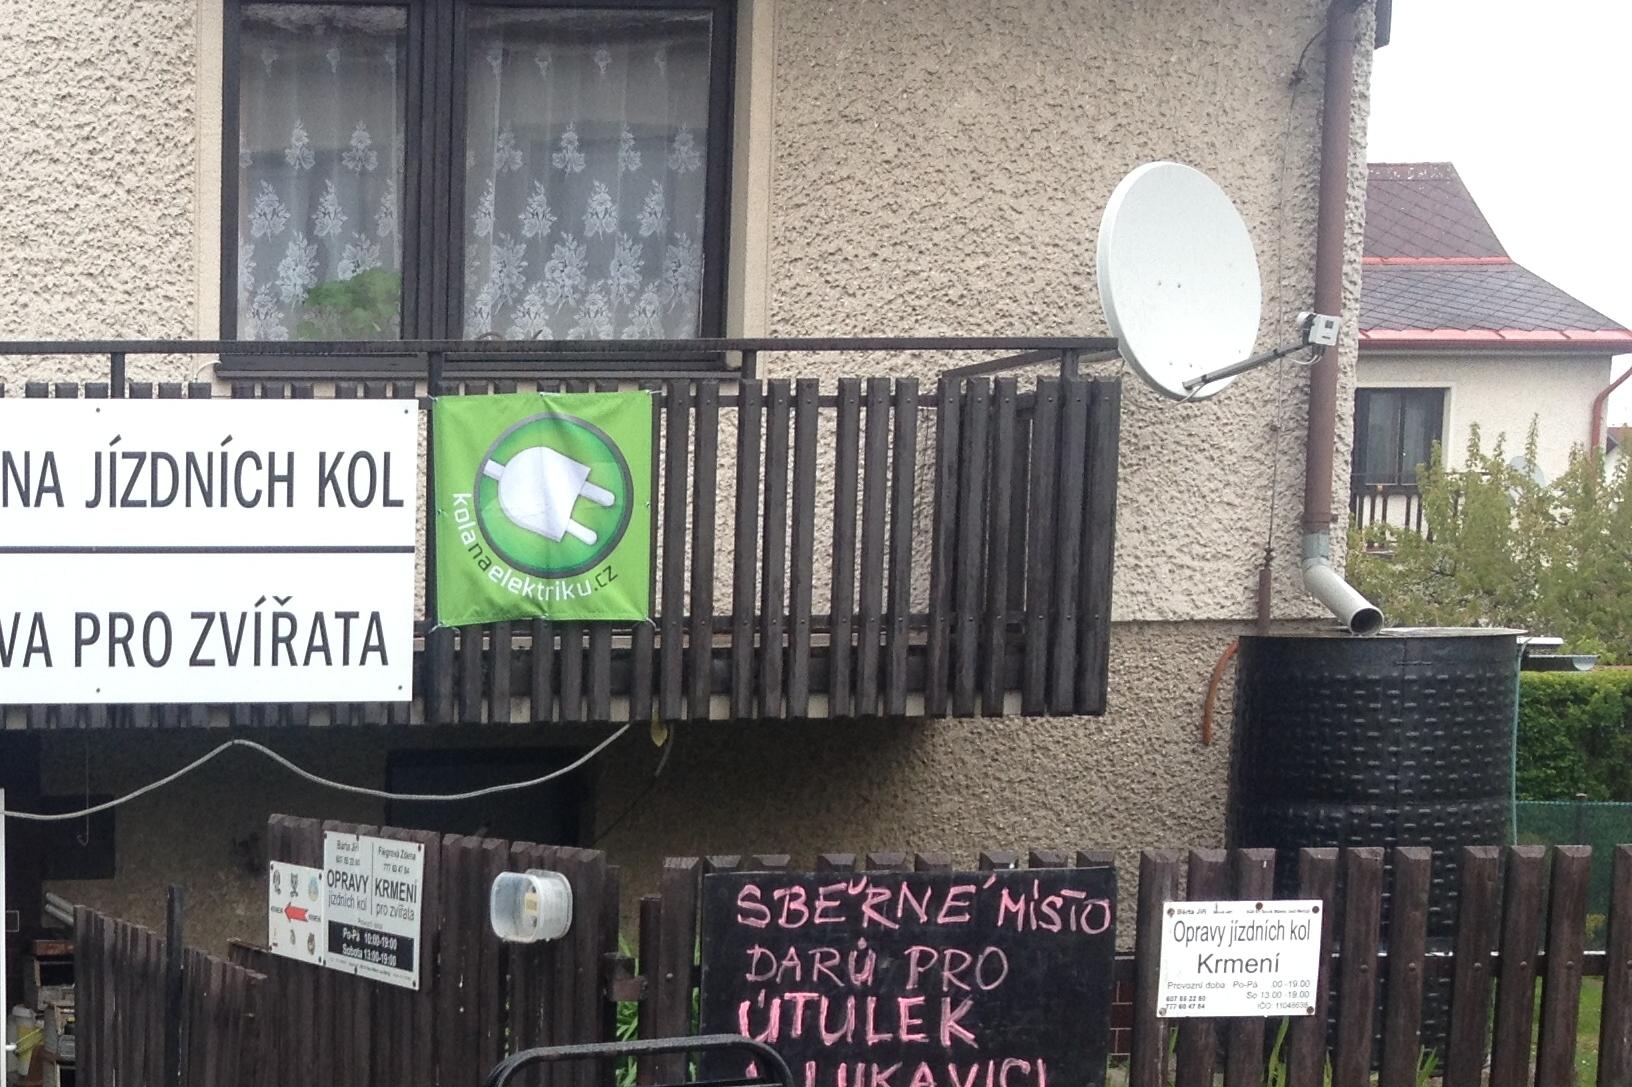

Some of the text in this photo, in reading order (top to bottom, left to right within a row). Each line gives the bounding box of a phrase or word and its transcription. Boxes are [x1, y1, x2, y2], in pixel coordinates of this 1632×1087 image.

[84, 433, 295, 509] JÍZDNÍCH
[317, 449, 405, 509] KOL
[451, 492, 619, 602] kolanaelektriku.cz
[73, 610, 173, 668] PRO
[188, 594, 390, 668] ZVÍŘATA
[327, 869, 369, 894] OPRAVY
[374, 877, 417, 904] KRMENÍ
[376, 903, 388, 917] pro
[1173, 919, 1311, 948] Opravy jízdních kol
[745, 936, 1009, 990] DARŮ PRO
[1197, 952, 1280, 975] Krmení
[1205, 981, 1225, 990] doba
[738, 988, 980, 1049] ÚTULEK
